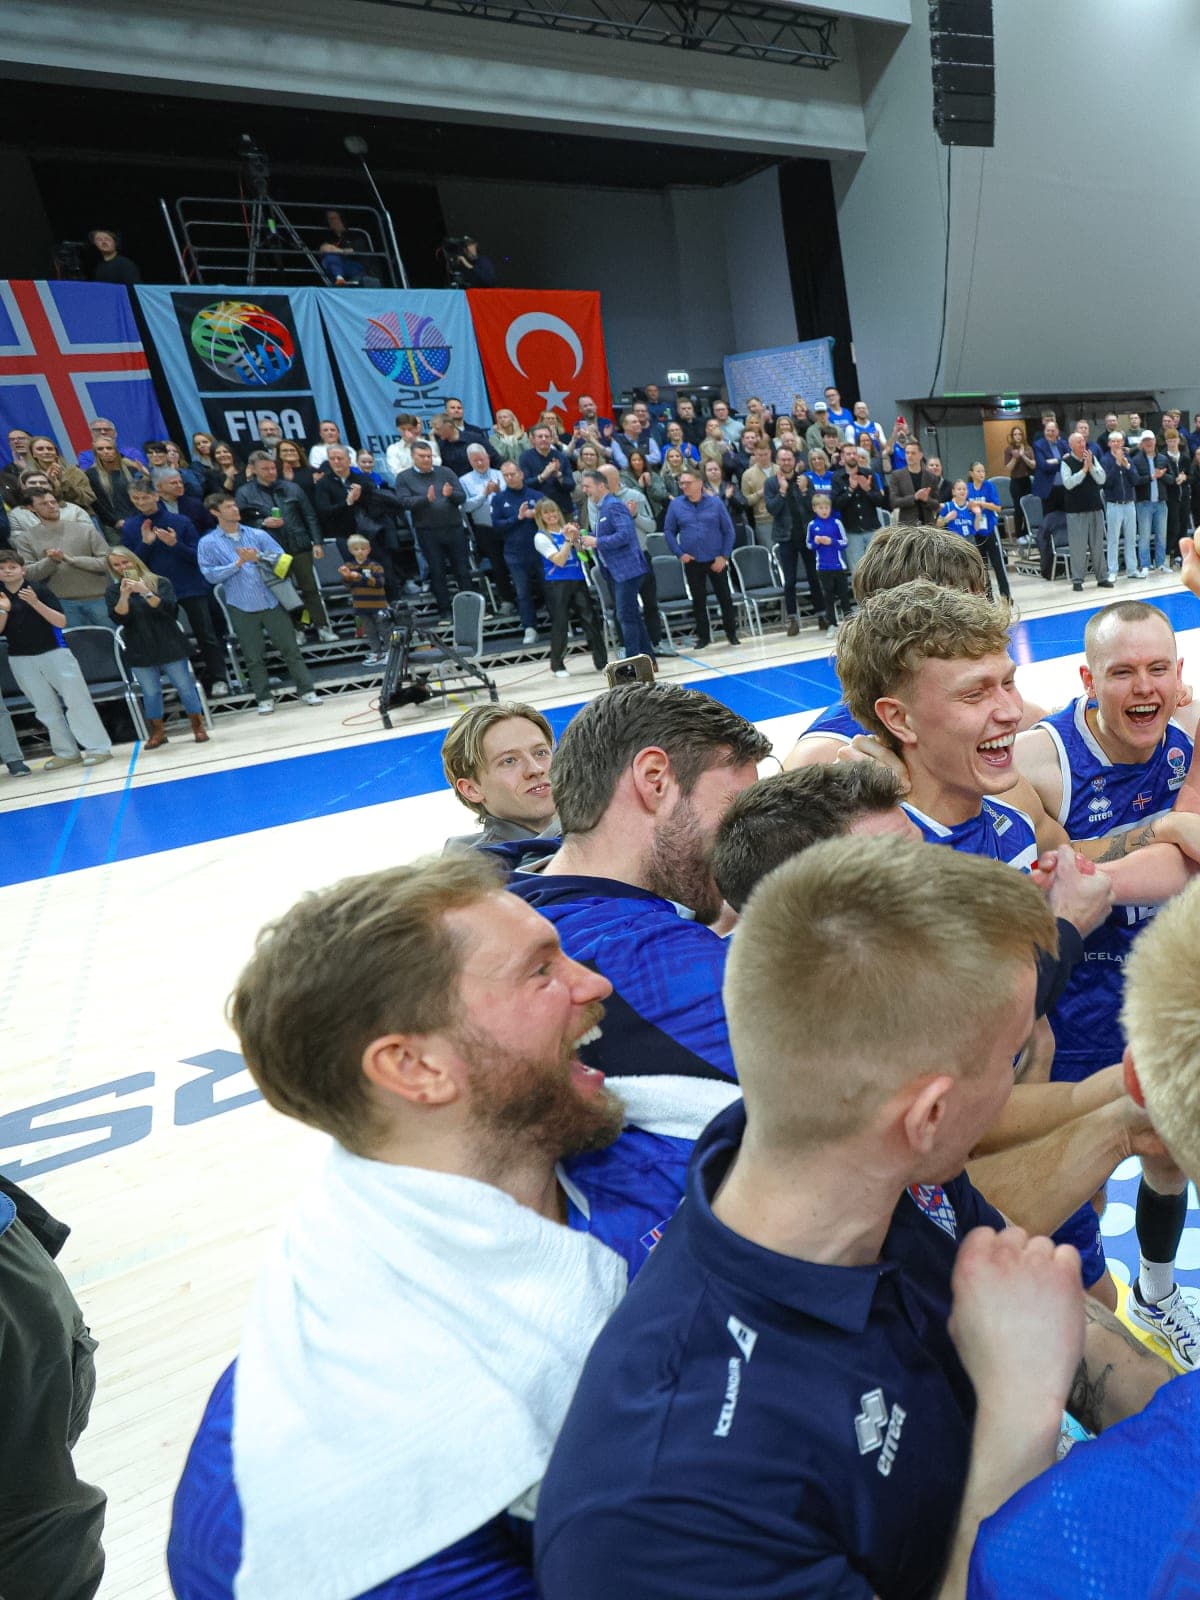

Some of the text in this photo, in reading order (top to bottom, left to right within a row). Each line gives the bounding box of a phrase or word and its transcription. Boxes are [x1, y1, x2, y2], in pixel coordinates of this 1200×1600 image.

[1088, 810, 1114, 823] errea
[713, 1356, 742, 1438] ICELANDAIR
[876, 1402, 907, 1478] errea
